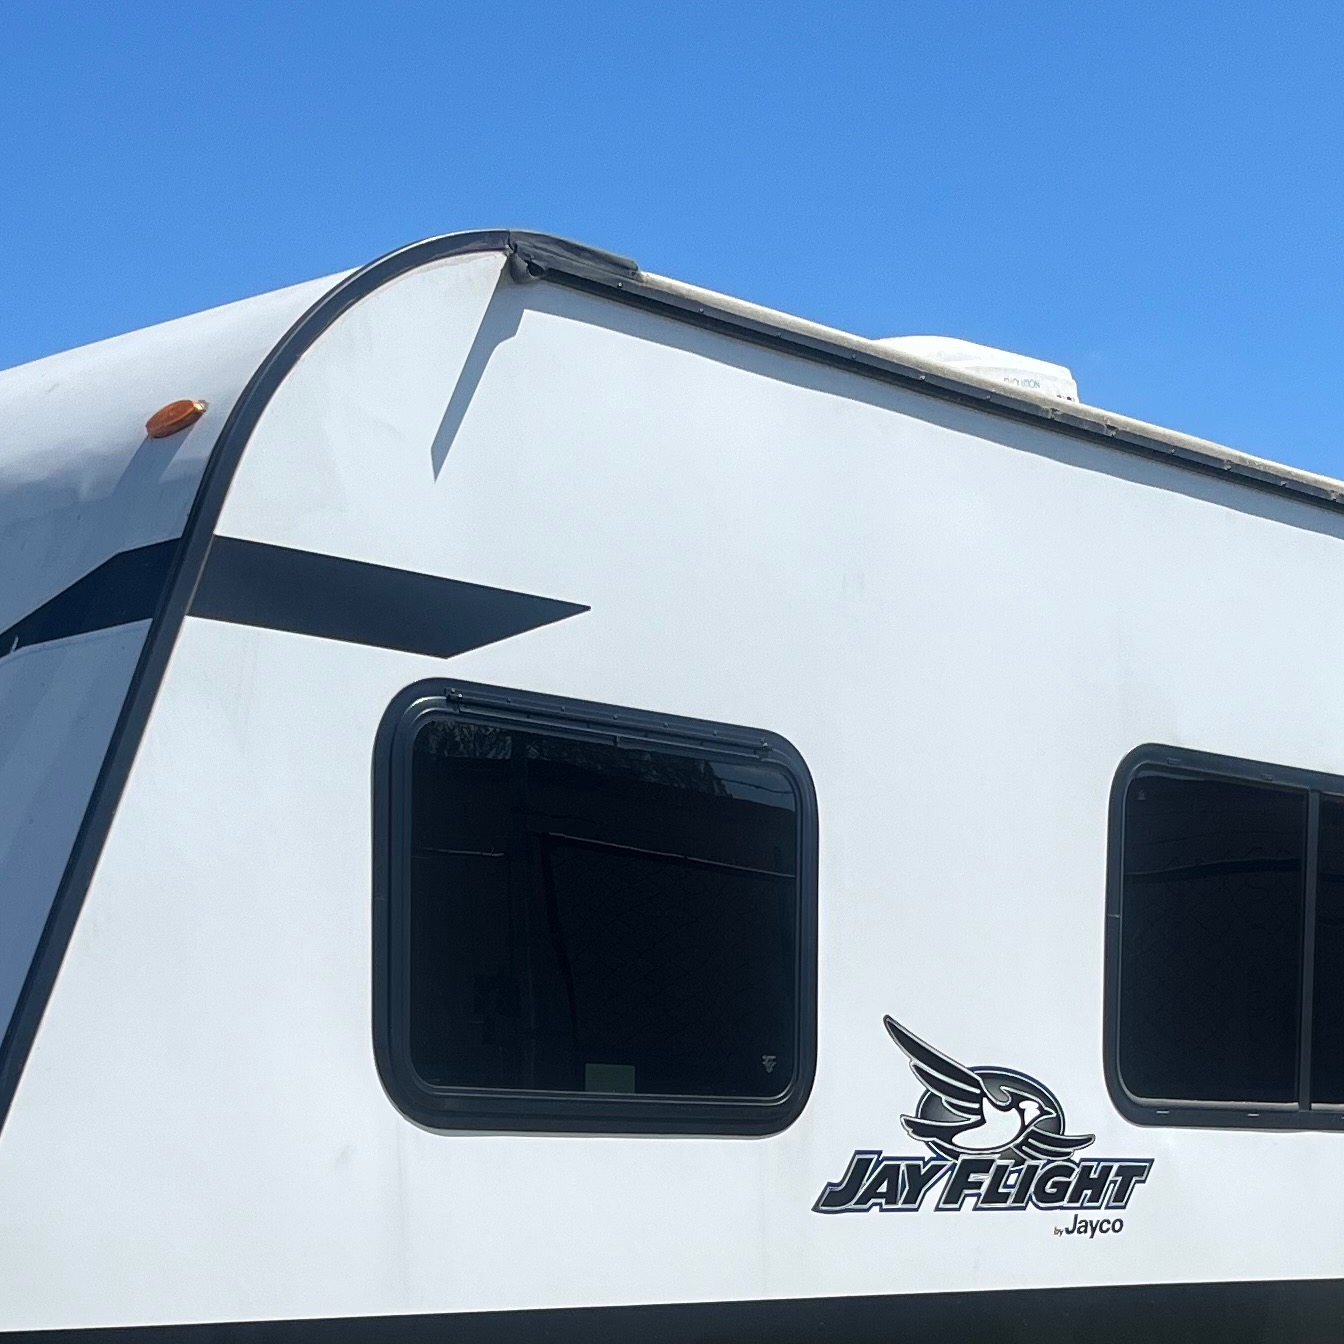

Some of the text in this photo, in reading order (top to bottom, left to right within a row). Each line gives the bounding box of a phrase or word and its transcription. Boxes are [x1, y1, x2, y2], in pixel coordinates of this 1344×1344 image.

[811, 1150, 1155, 1213] JAY FLIGHT
[1053, 1214, 1124, 1239] by Jayco
